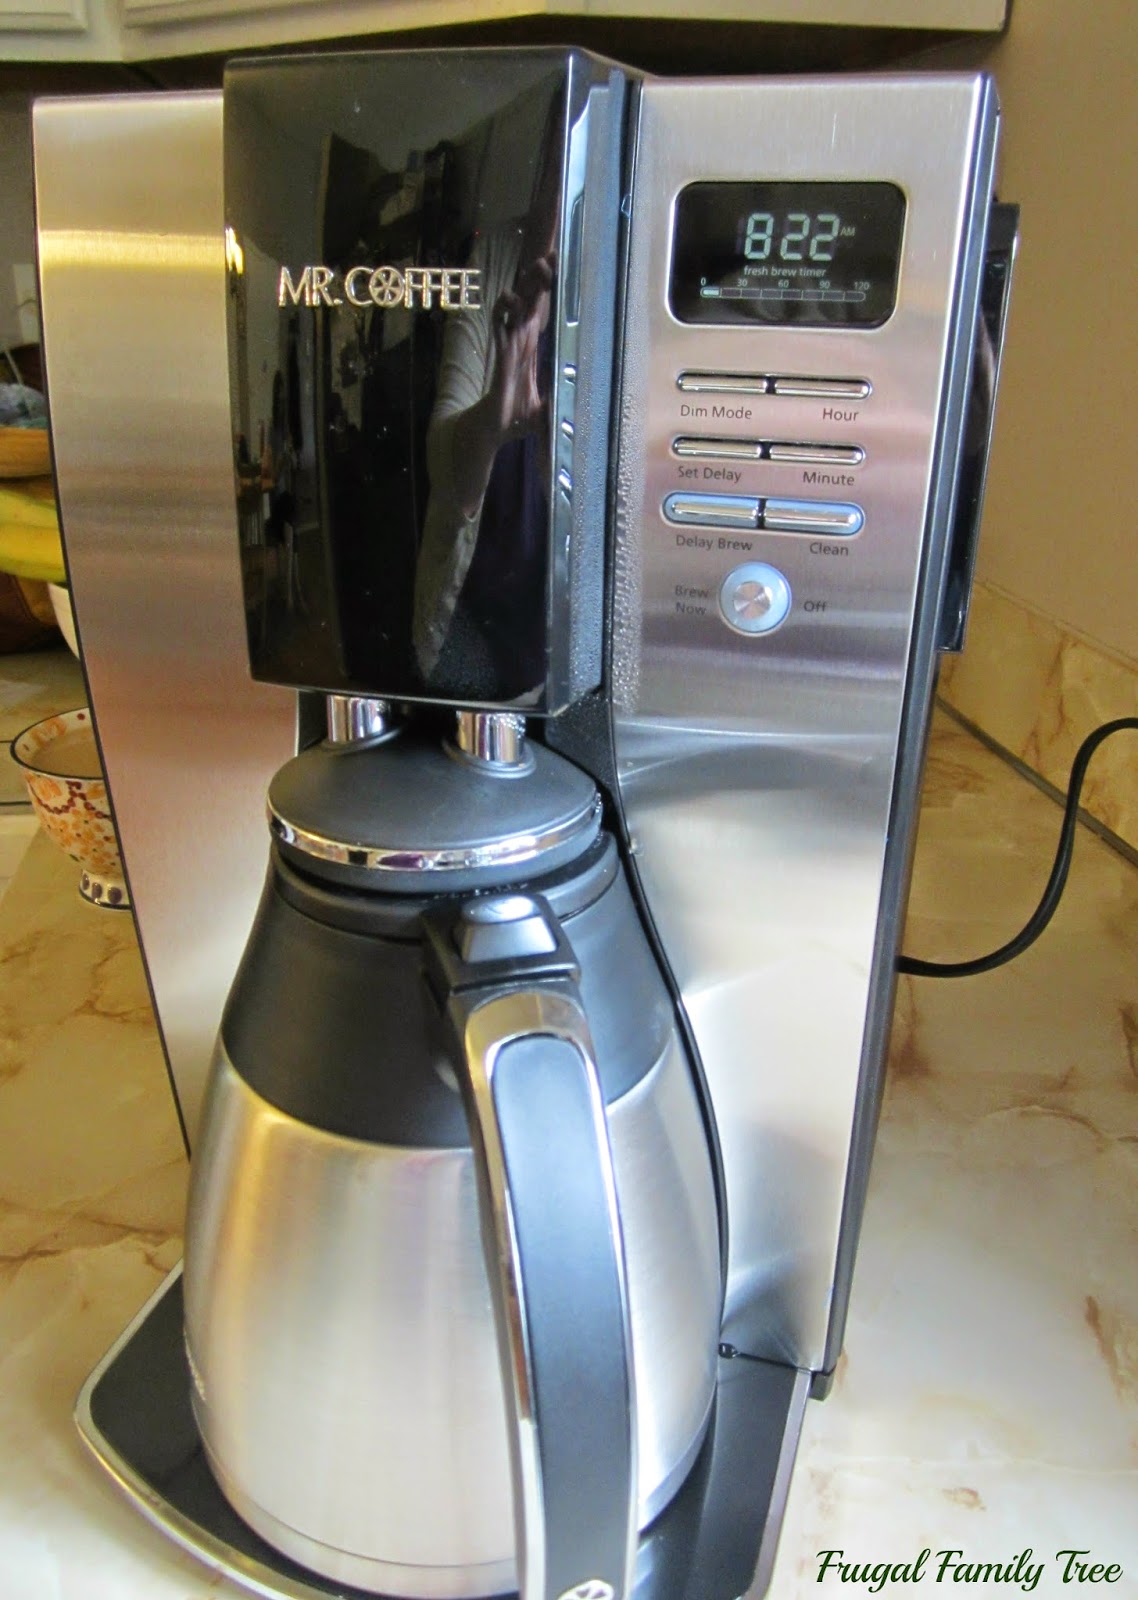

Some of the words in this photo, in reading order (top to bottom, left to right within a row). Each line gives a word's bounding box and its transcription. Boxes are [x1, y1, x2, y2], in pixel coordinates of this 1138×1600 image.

[840, 227, 855, 237] AM
[744, 267, 768, 276] fresh
[772, 267, 797, 276] brew
[799, 268, 826, 277] timer
[278, 266, 343, 307] MR.
[345, 266, 481, 309] COFFEE
[701, 278, 707, 286] 0
[737, 279, 748, 287] 30
[778, 280, 789, 288] 60
[819, 281, 830, 289] 90
[854, 281, 870, 290] 120
[680, 405, 708, 418] Dim
[712, 406, 752, 420] Mode
[822, 409, 859, 421] Hour
[678, 466, 698, 479] Set
[703, 467, 741, 483] Delay
[802, 471, 855, 486] Minute
[676, 535, 713, 550] Delay
[718, 538, 752, 550] Brew
[809, 542, 849, 556] Clean
[675, 586, 709, 598] Brew
[676, 602, 707, 615] Now
[804, 601, 827, 613] Off
